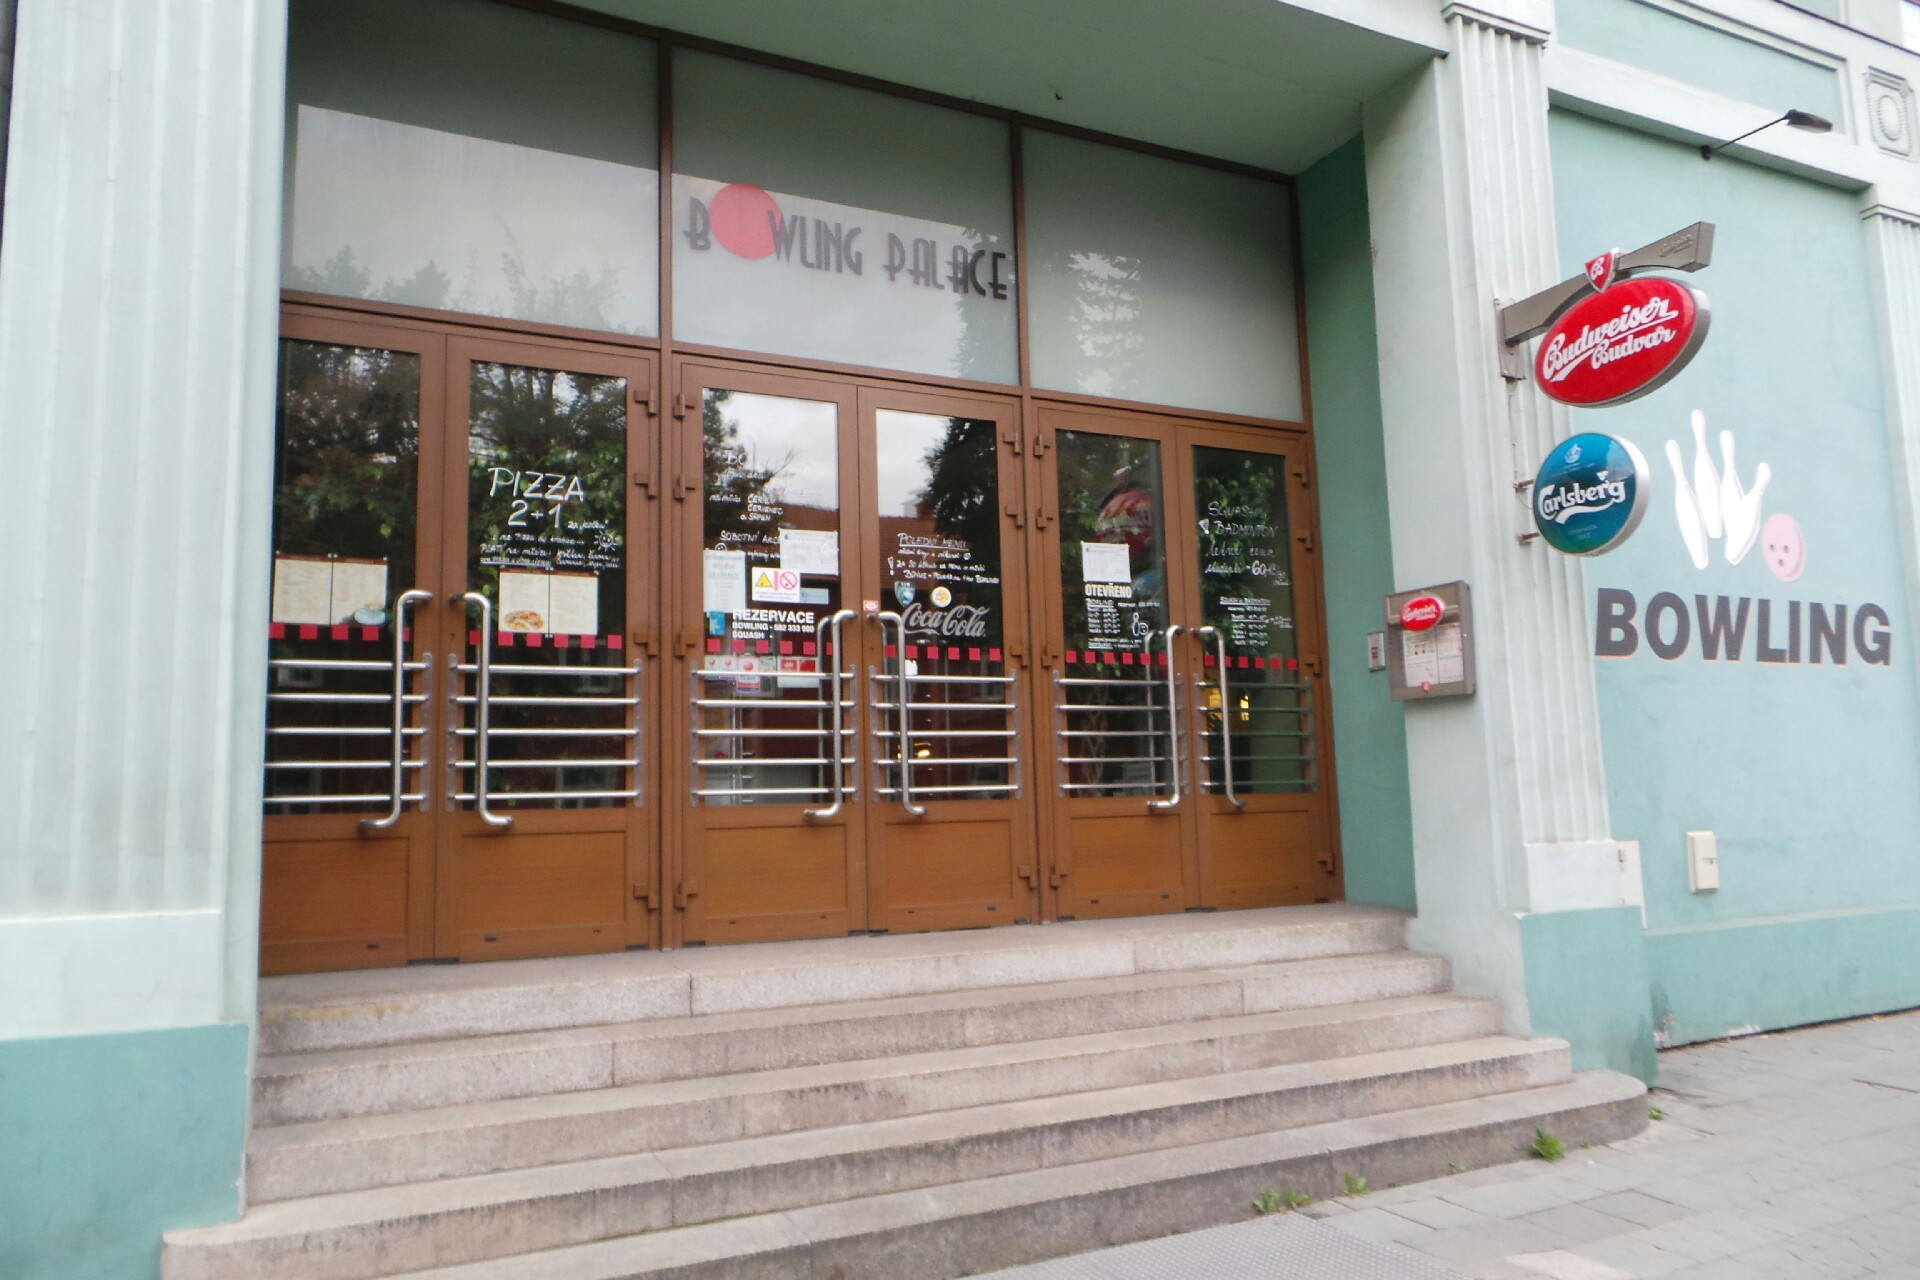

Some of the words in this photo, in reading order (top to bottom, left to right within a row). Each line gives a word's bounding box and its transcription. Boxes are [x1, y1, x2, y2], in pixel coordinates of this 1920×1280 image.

[883, 232, 1007, 300] PALACE
[1543, 297, 1679, 381] Budweiser
[1590, 326, 1676, 370] Budvar
[488, 467, 584, 502] PIZZA
[1538, 480, 1626, 522] Carlsberg
[720, 530, 760, 542] SOBOTNÍ
[1213, 520, 1279, 537] BADMINTON
[897, 532, 940, 546] POLEDNÍ
[1085, 583, 1132, 599] OTEVŘENO
[732, 609, 814, 623] REZERVACE
[732, 622, 768, 631] BOWLING
[732, 631, 764, 639] SQUASH
[1595, 588, 1892, 667] BOWLING
